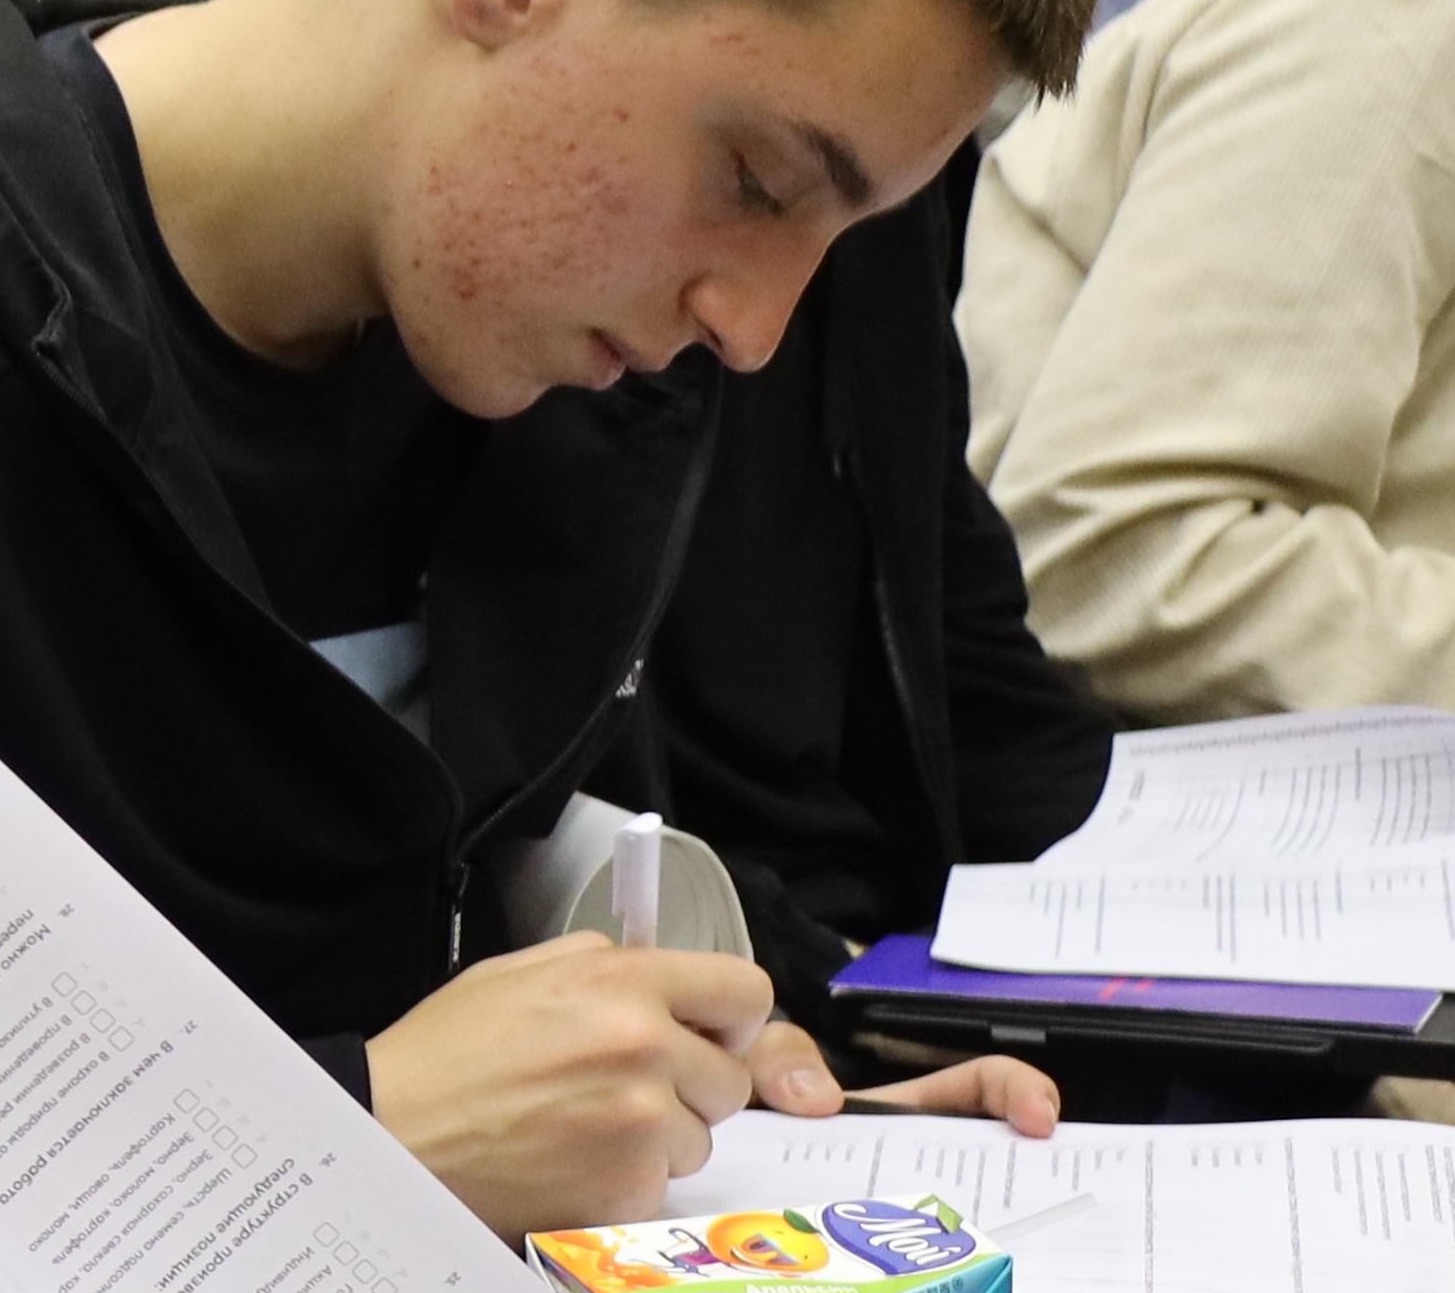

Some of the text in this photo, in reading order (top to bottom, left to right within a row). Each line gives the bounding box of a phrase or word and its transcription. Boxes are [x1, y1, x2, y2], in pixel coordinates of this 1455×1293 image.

[10, 1038, 81, 1105] разведении
[54, 1057, 99, 1099] охране
[130, 1049, 161, 1078] чем
[4, 1094, 58, 1146] природы
[44, 1074, 134, 1159] заключается
[26, 1110, 176, 1253] Картофель, овощи, молоко
[170, 1146, 214, 1189] Зерно,
[181, 1164, 233, 1215] Шерсть,
[48, 1129, 195, 1268] Зерно, молоко, картофель
[117, 1181, 175, 1237] сахарная
[152, 1153, 296, 1292] следующие позиции:
[226, 1179, 301, 1248] структуре
[77, 1233, 123, 1276] свекла,
[141, 1209, 185, 1252] семена
[833, 1203, 961, 1265] Мой
